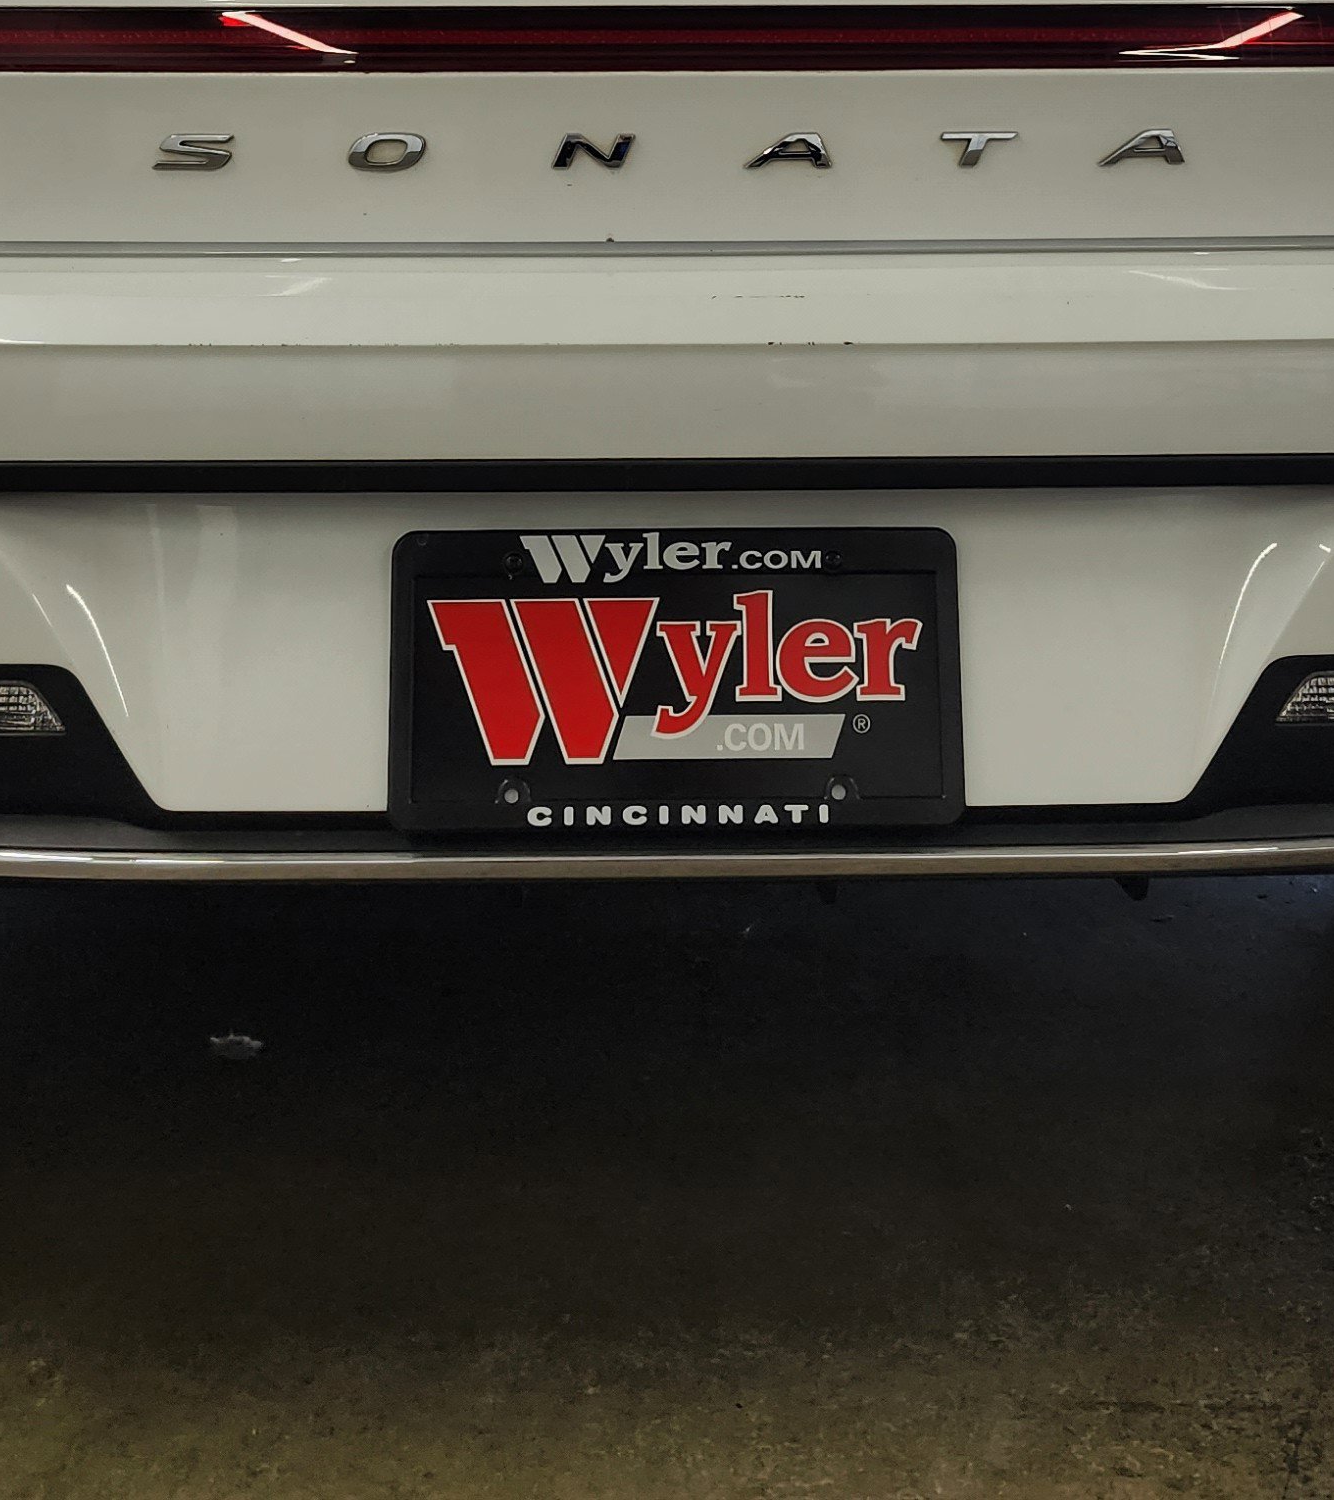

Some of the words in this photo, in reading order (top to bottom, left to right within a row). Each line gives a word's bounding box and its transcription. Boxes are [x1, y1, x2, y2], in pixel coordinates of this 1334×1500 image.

[152, 128, 1186, 172] SONATA
[427, 589, 922, 766] Wyler
[715, 722, 805, 752] .COM
[526, 803, 830, 827] CINCINNATI
